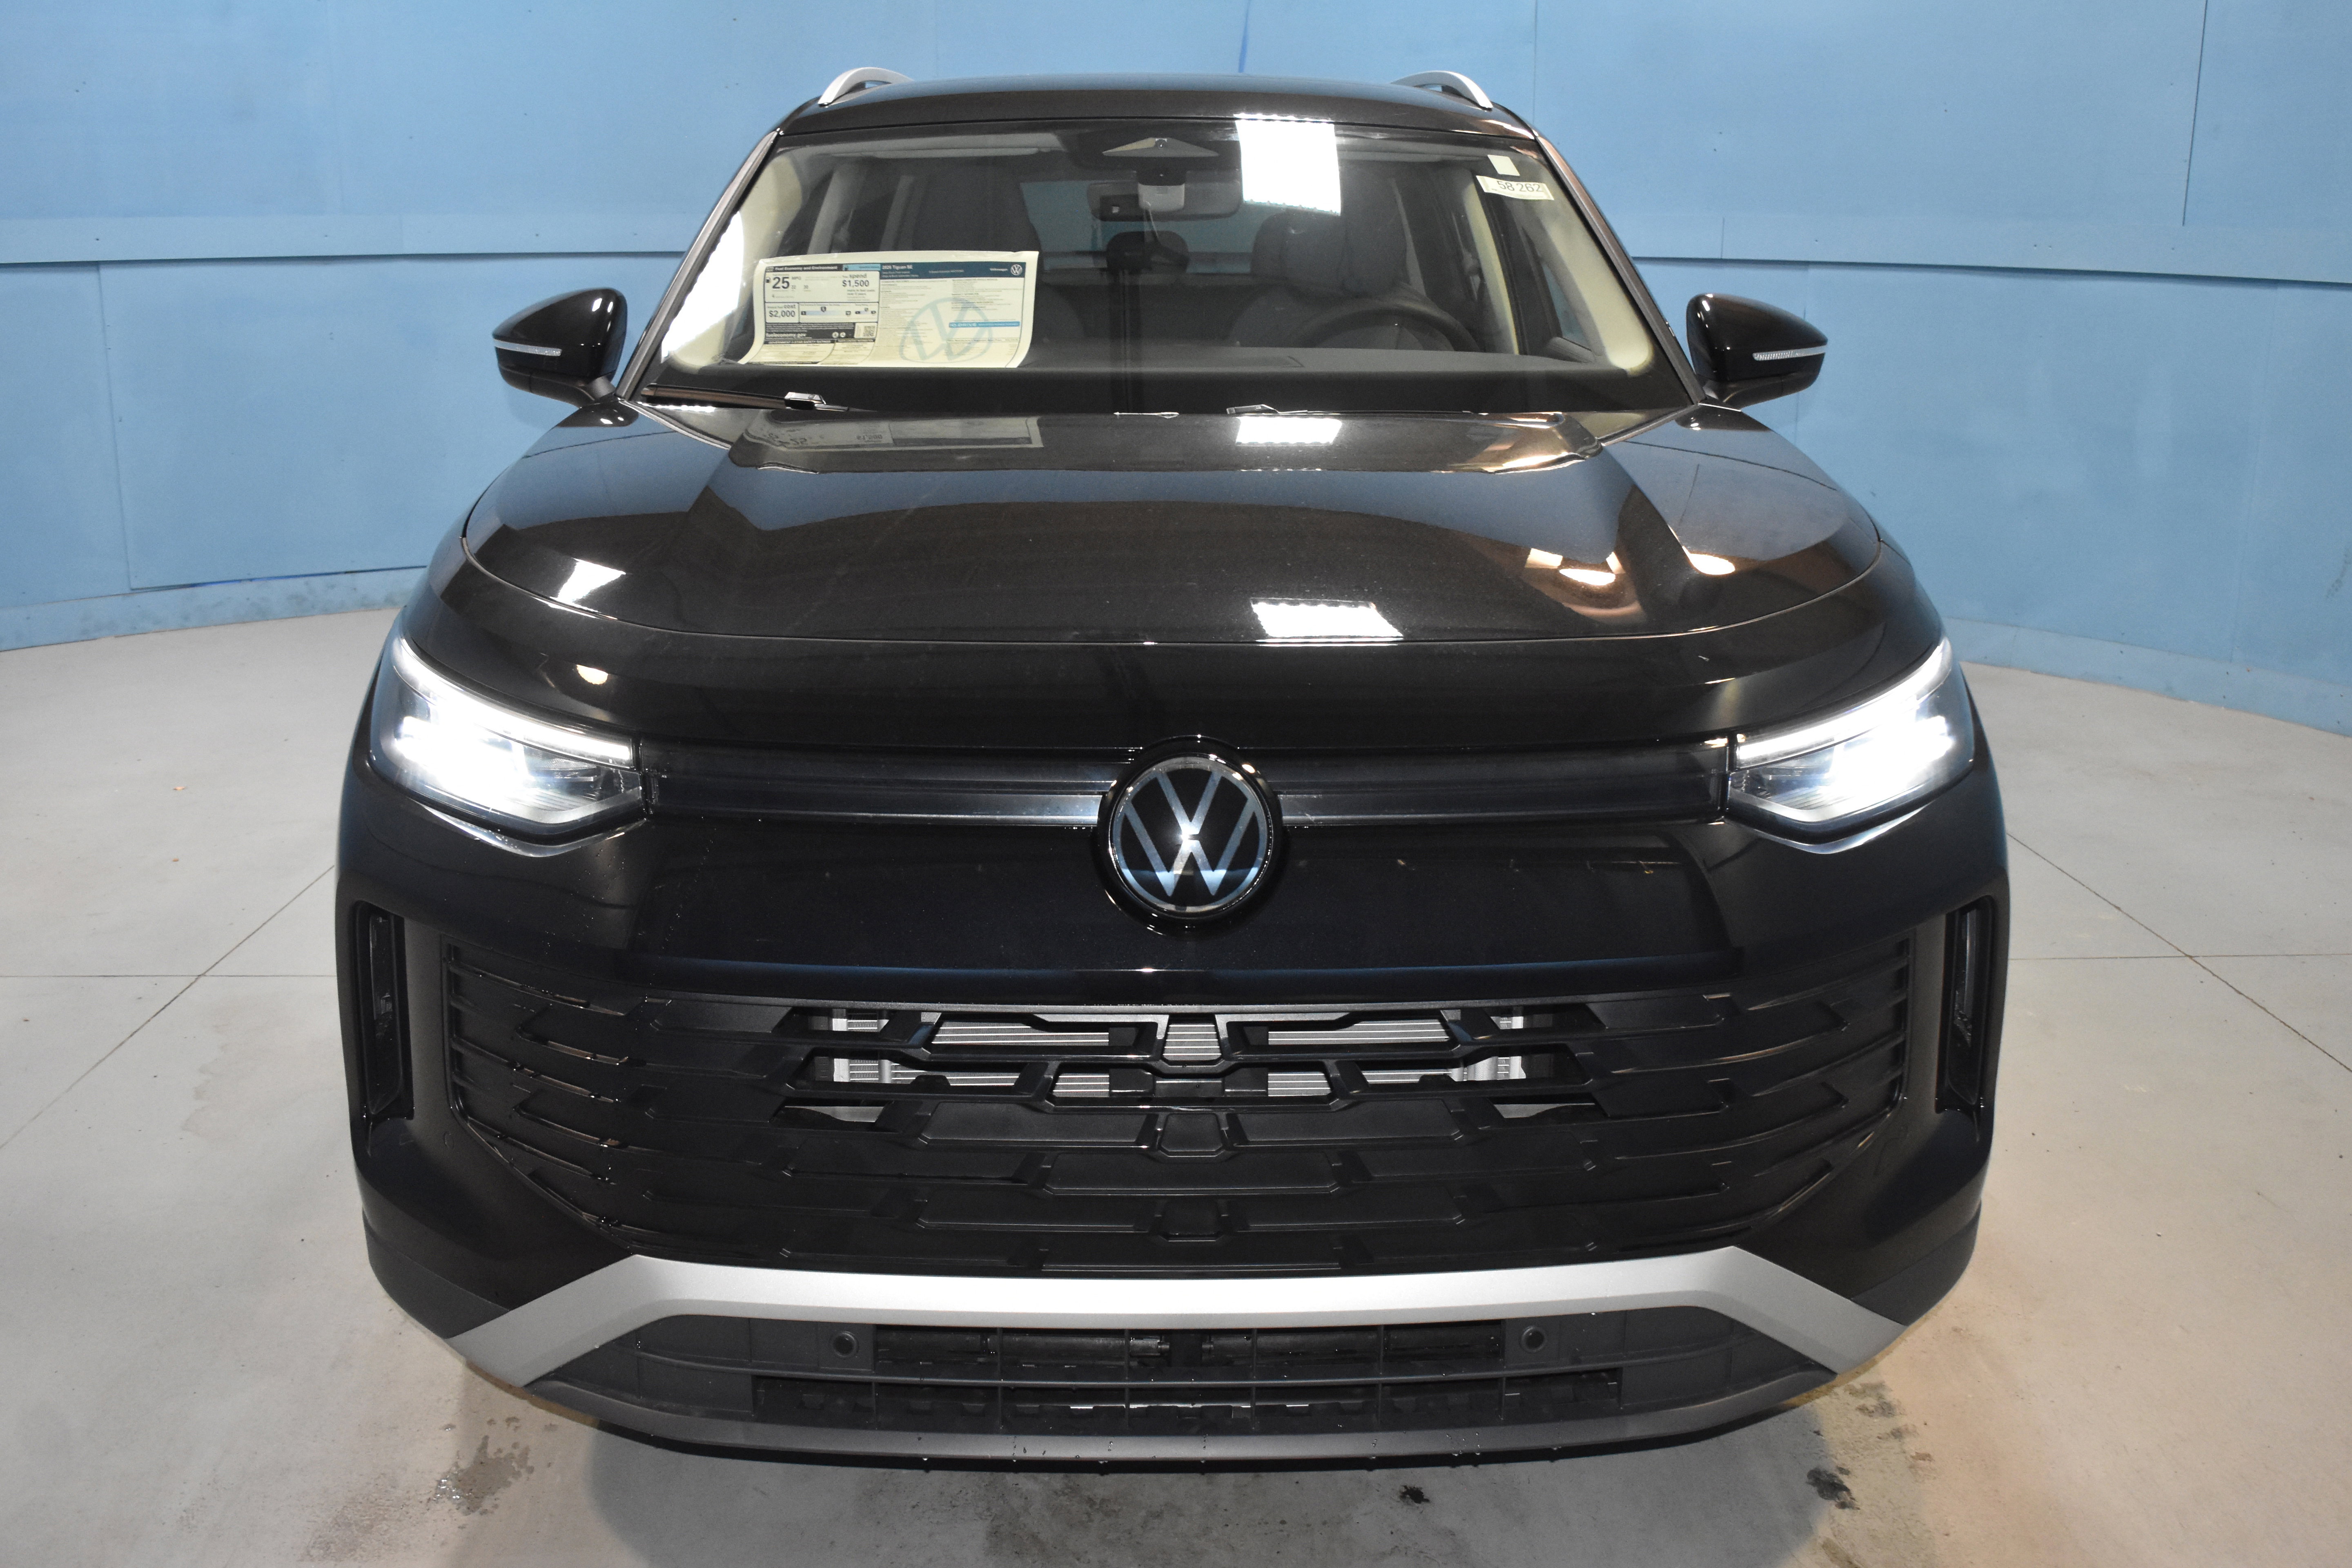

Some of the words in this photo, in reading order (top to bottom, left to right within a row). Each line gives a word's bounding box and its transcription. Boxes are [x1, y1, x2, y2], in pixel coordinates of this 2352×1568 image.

[1497, 180, 1515, 191] 58
[1516, 183, 1544, 192] 262
[772, 276, 790, 289] 25
[1117, 762, 1264, 905] VW
